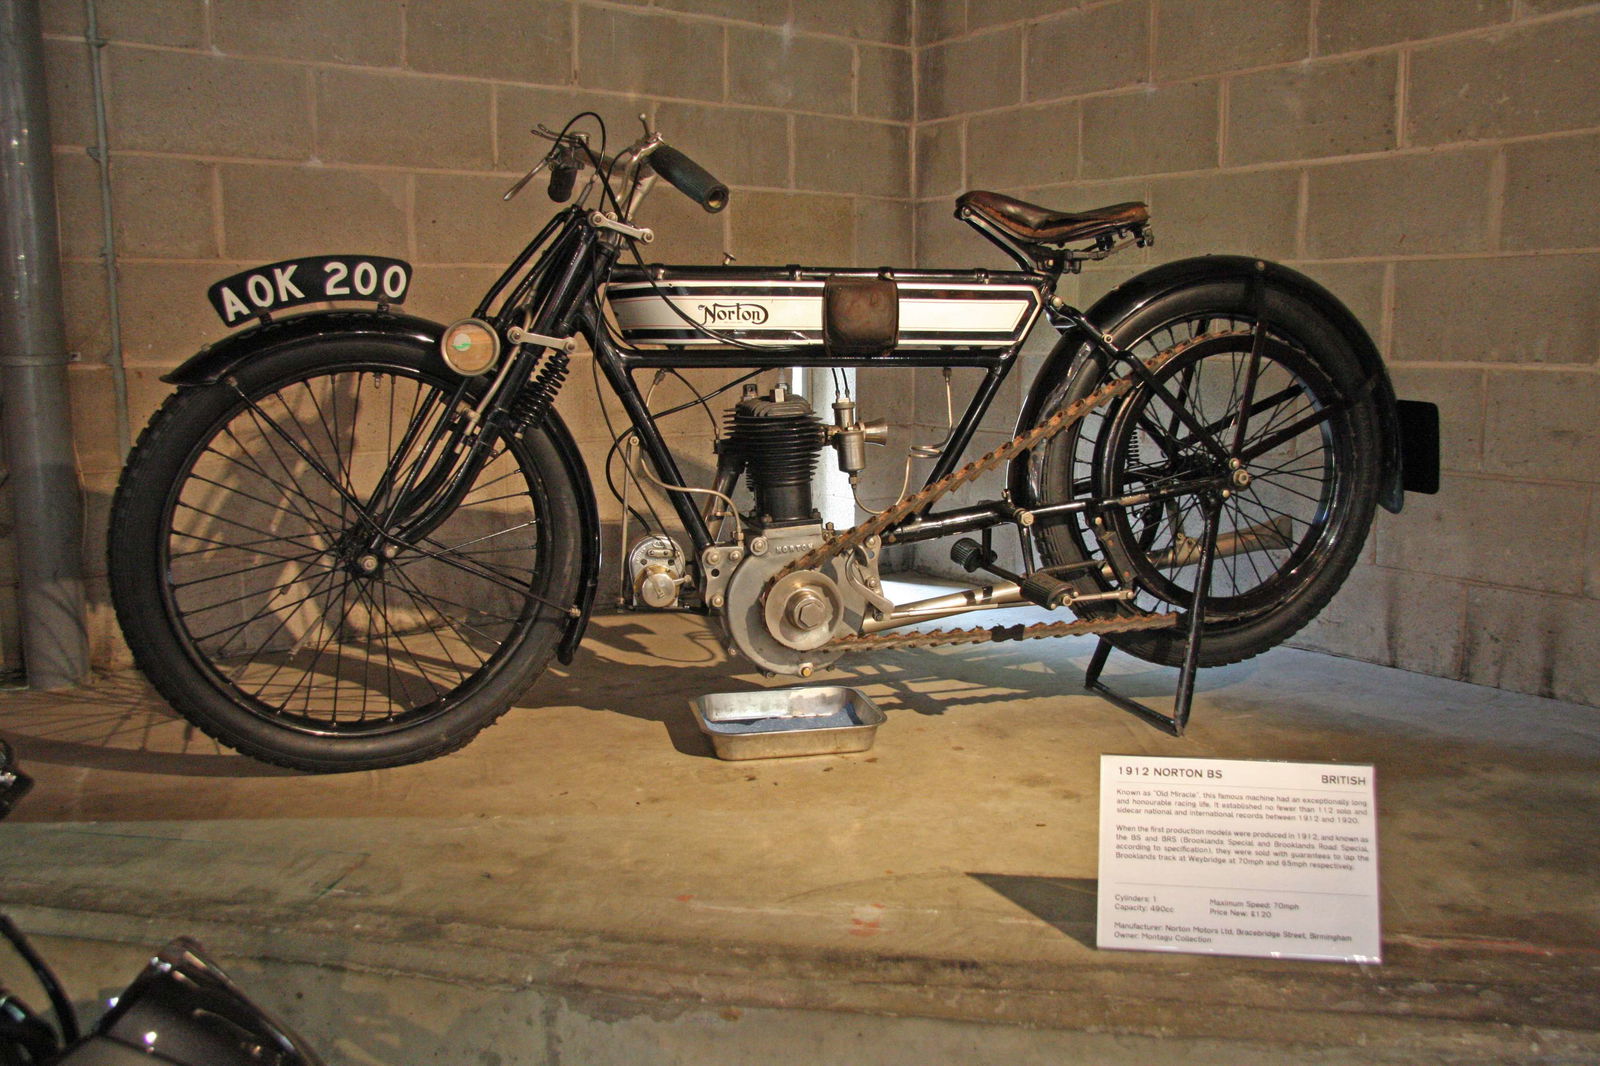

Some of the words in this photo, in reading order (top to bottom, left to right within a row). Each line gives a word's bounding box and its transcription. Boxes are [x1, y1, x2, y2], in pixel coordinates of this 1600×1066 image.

[221, 264, 306, 322] AOK
[324, 261, 407, 298] 200
[698, 303, 769, 325] Norton
[776, 543, 814, 553] NORTON
[1119, 766, 1149, 776] 1912
[1153, 767, 1203, 778] NORTON
[1207, 769, 1223, 779] BS
[1321, 774, 1366, 786] BRITISH
[1221, 802, 1262, 810] established
[1246, 794, 1274, 802] machine
[1302, 797, 1349, 806] exceptionally
[1351, 799, 1367, 807] long
[1190, 810, 1234, 818] international
[1116, 824, 1136, 832] When
[1166, 827, 1204, 836] production
[1253, 831, 1287, 839] produced
[1180, 836, 1223, 845] (Brooklands
[1274, 841, 1315, 849] Brooklands
[1115, 843, 1151, 851] according
[1215, 847, 1231, 855] they
[1291, 852, 1330, 860] guarantees
[1115, 852, 1156, 860] Brooklands
[1188, 855, 1226, 864] Weybridge
[1238, 858, 1264, 866] 70mph
[1281, 860, 1307, 868] 65mph
[1114, 894, 1149, 902] Cylinders:
[1209, 899, 1244, 907] Maximum
[1246, 900, 1271, 909] Speed:
[1274, 902, 1299, 910] 70mph
[1114, 903, 1148, 912] Capacity:
[1150, 905, 1174, 913] 490cc
[1113, 931, 1138, 939] Owner:
[1141, 933, 1172, 941] Montagu
[1174, 935, 1211, 943] Collection
[1114, 922, 1163, 930] Manufacturer:
[1193, 926, 1218, 934] Motors
[1236, 929, 1281, 938] Bracebridge
[1309, 932, 1352, 941] Birmingham
